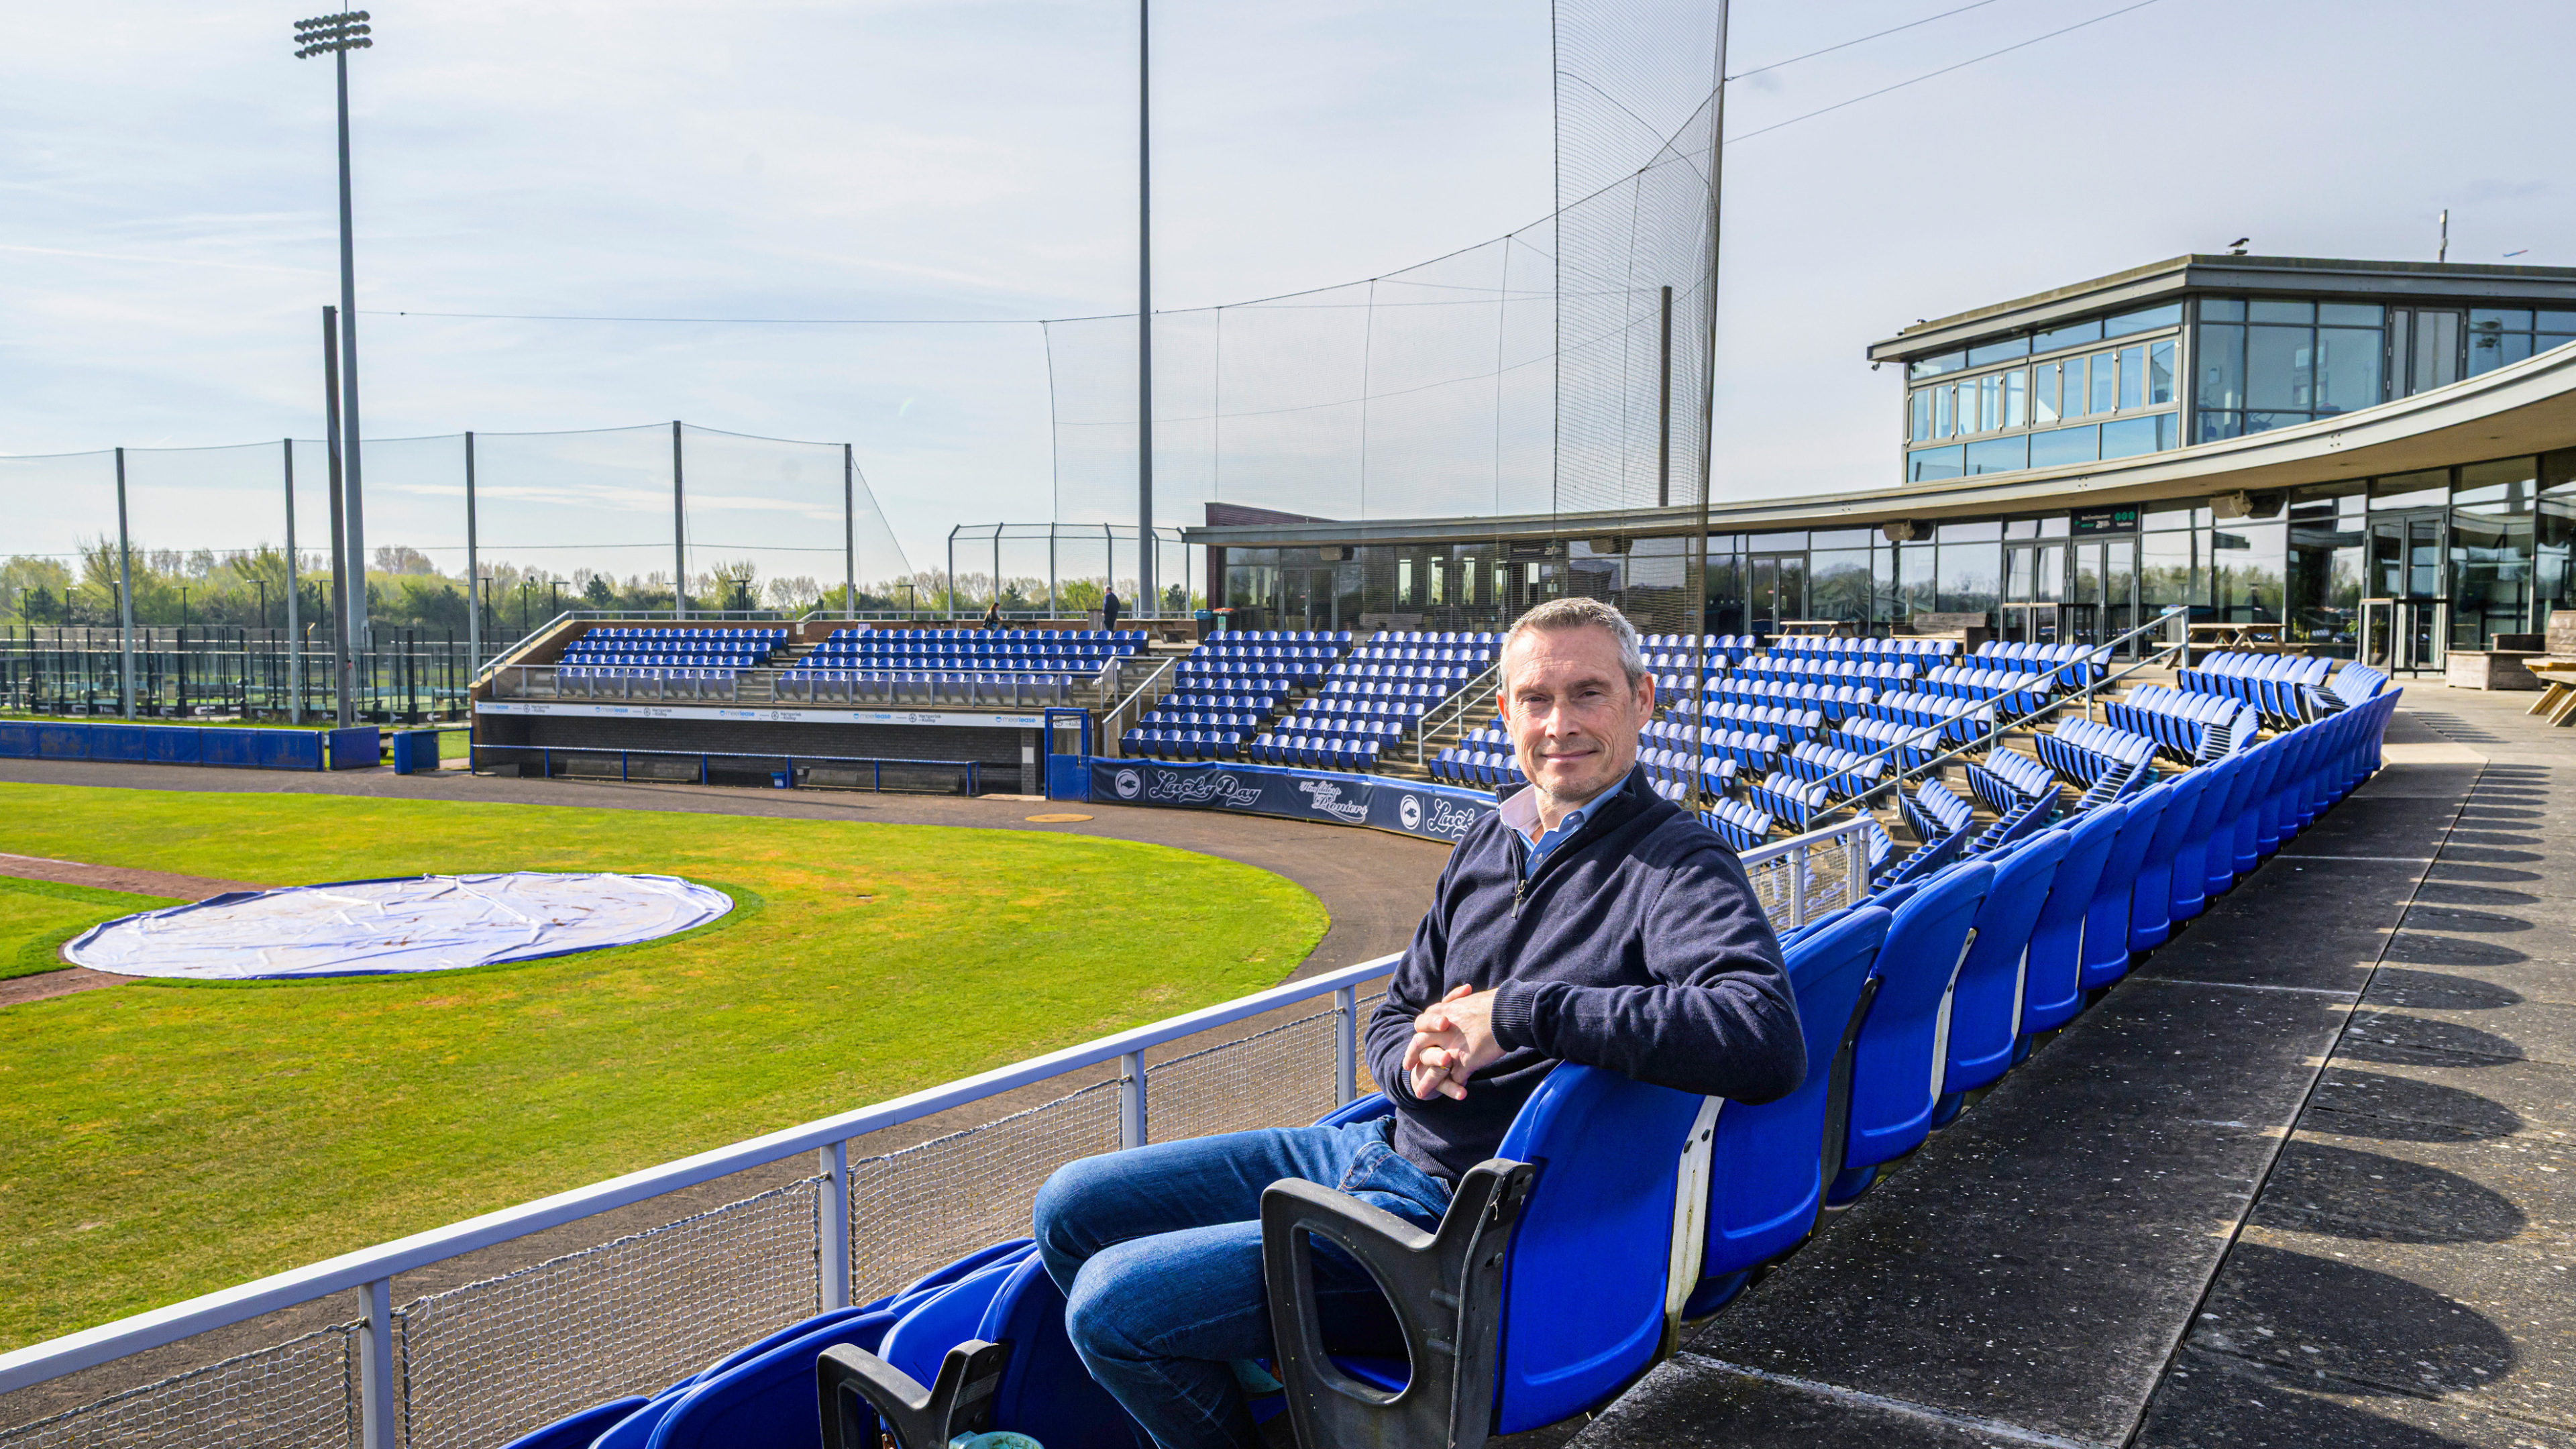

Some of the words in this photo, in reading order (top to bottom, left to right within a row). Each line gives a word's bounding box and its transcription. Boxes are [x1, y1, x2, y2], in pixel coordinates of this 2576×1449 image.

[1148, 769, 1218, 803] Lucky
[1216, 775, 1263, 806] Day
[1311, 794, 1368, 820] Pioniers
[1426, 798, 1474, 839] Luck
